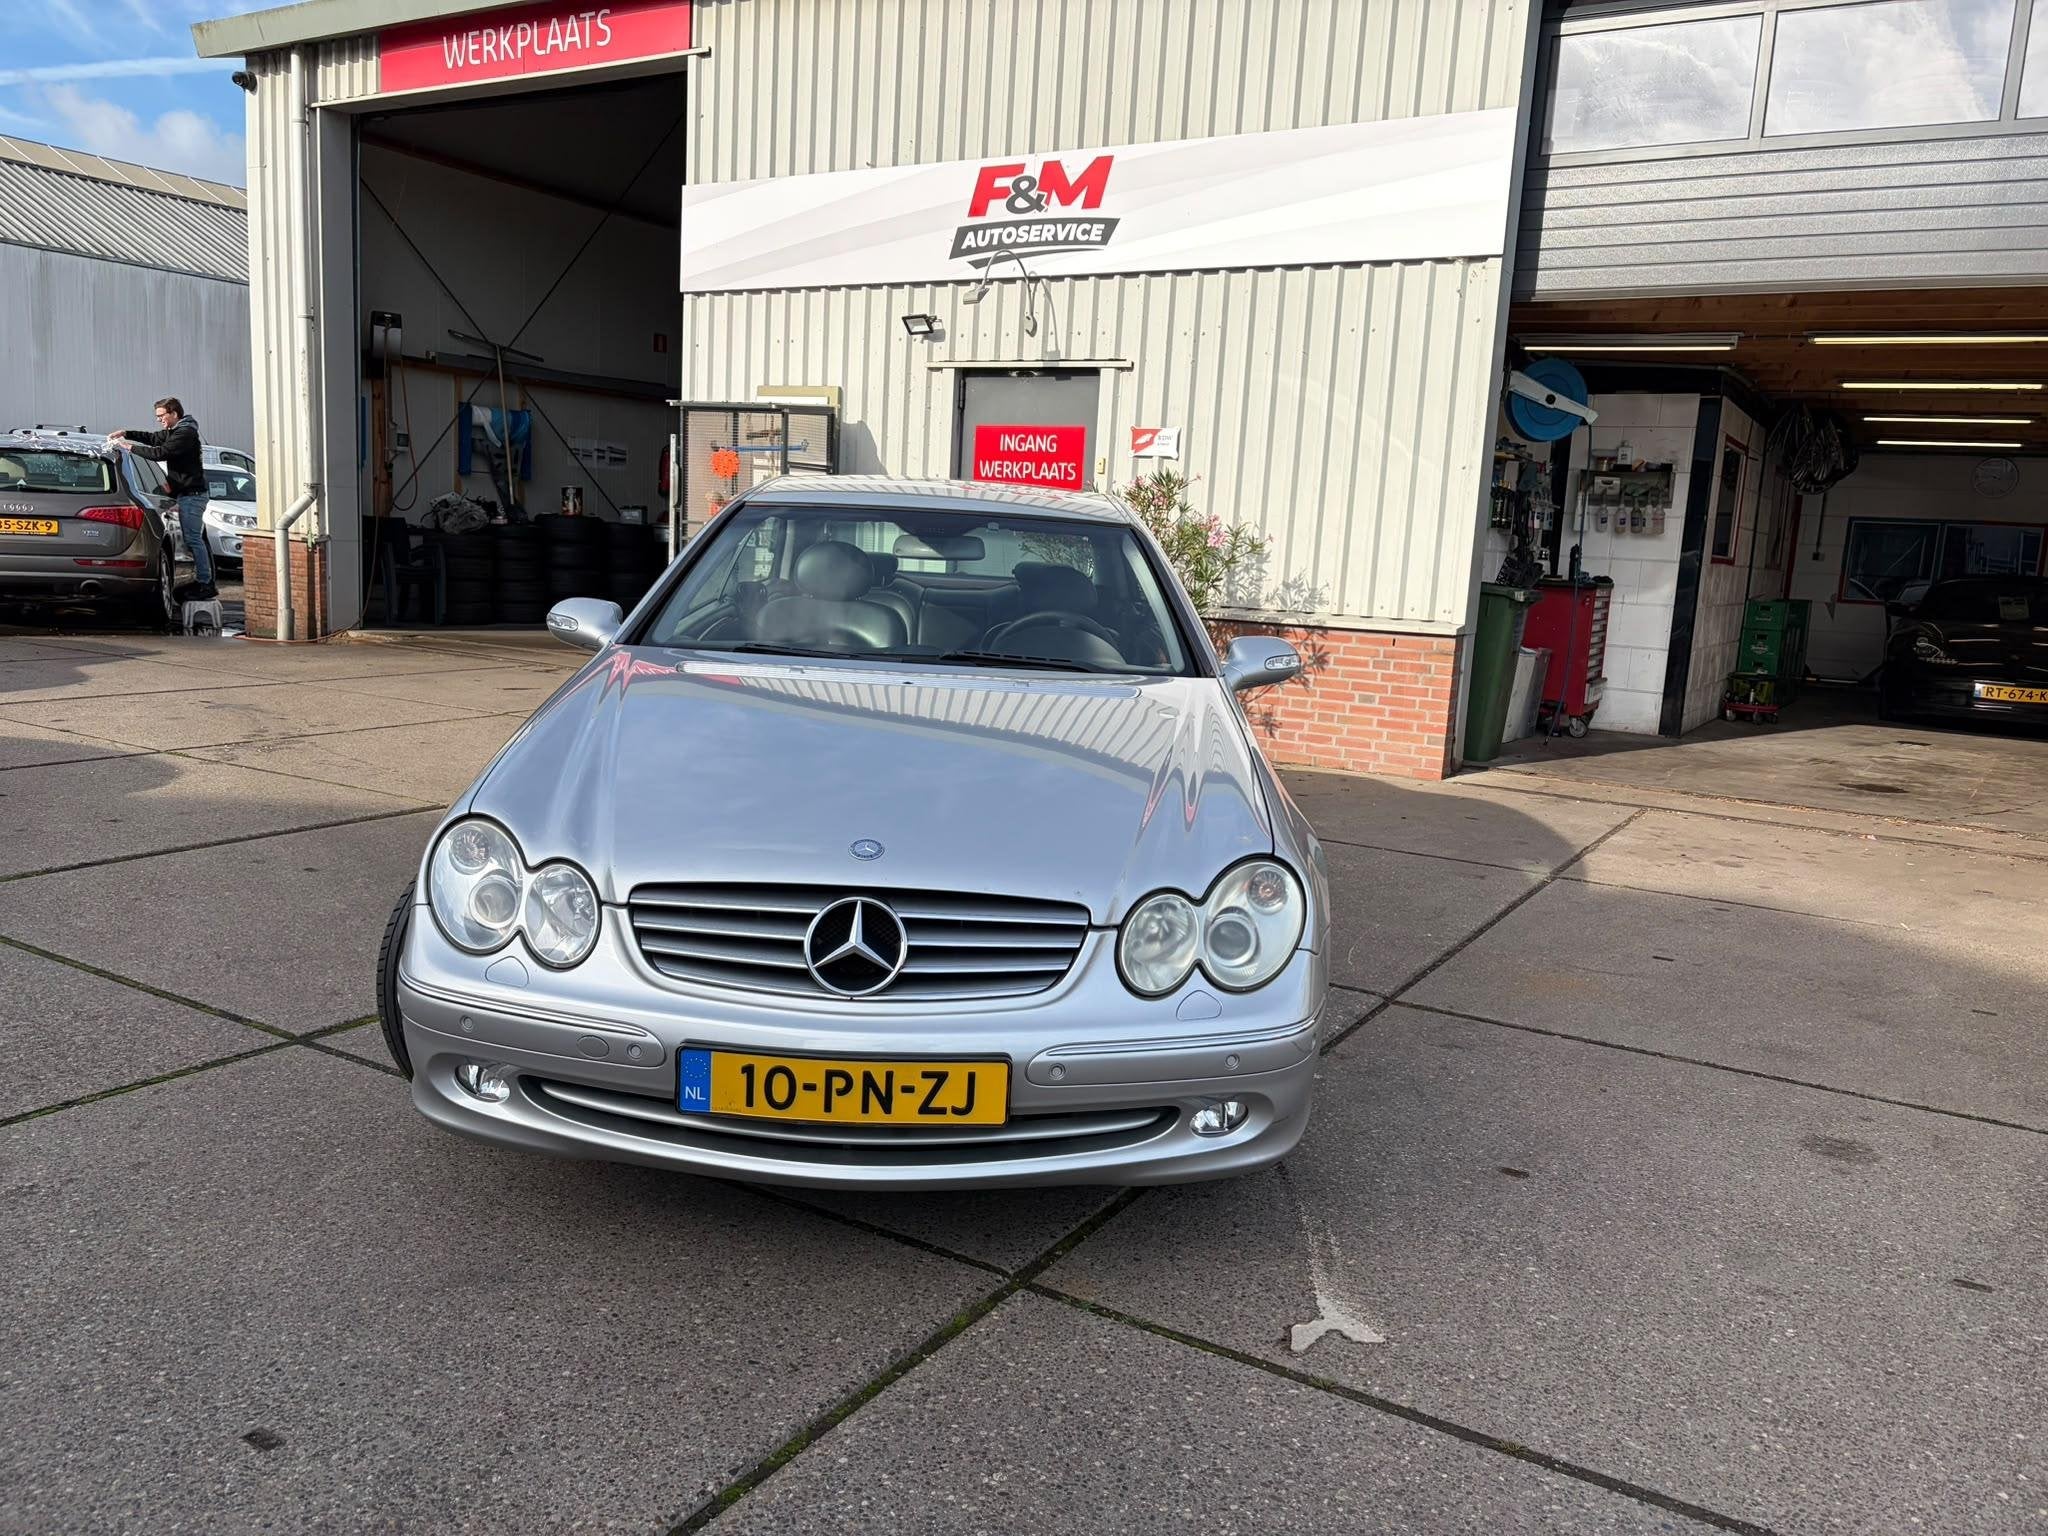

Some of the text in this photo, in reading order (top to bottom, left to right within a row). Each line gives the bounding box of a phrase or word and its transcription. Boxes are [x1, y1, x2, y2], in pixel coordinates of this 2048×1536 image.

[443, 9, 611, 69] WERKPLAATS
[968, 155, 1114, 217] F&M
[961, 223, 1105, 249] AUTOSERVICE
[1000, 433, 1057, 452] INGANG
[980, 460, 1076, 480] WERKPLAATS
[1985, 686, 2048, 700] RT-674-K
[685, 1064, 976, 1117] NL 10-PN-ZJ
